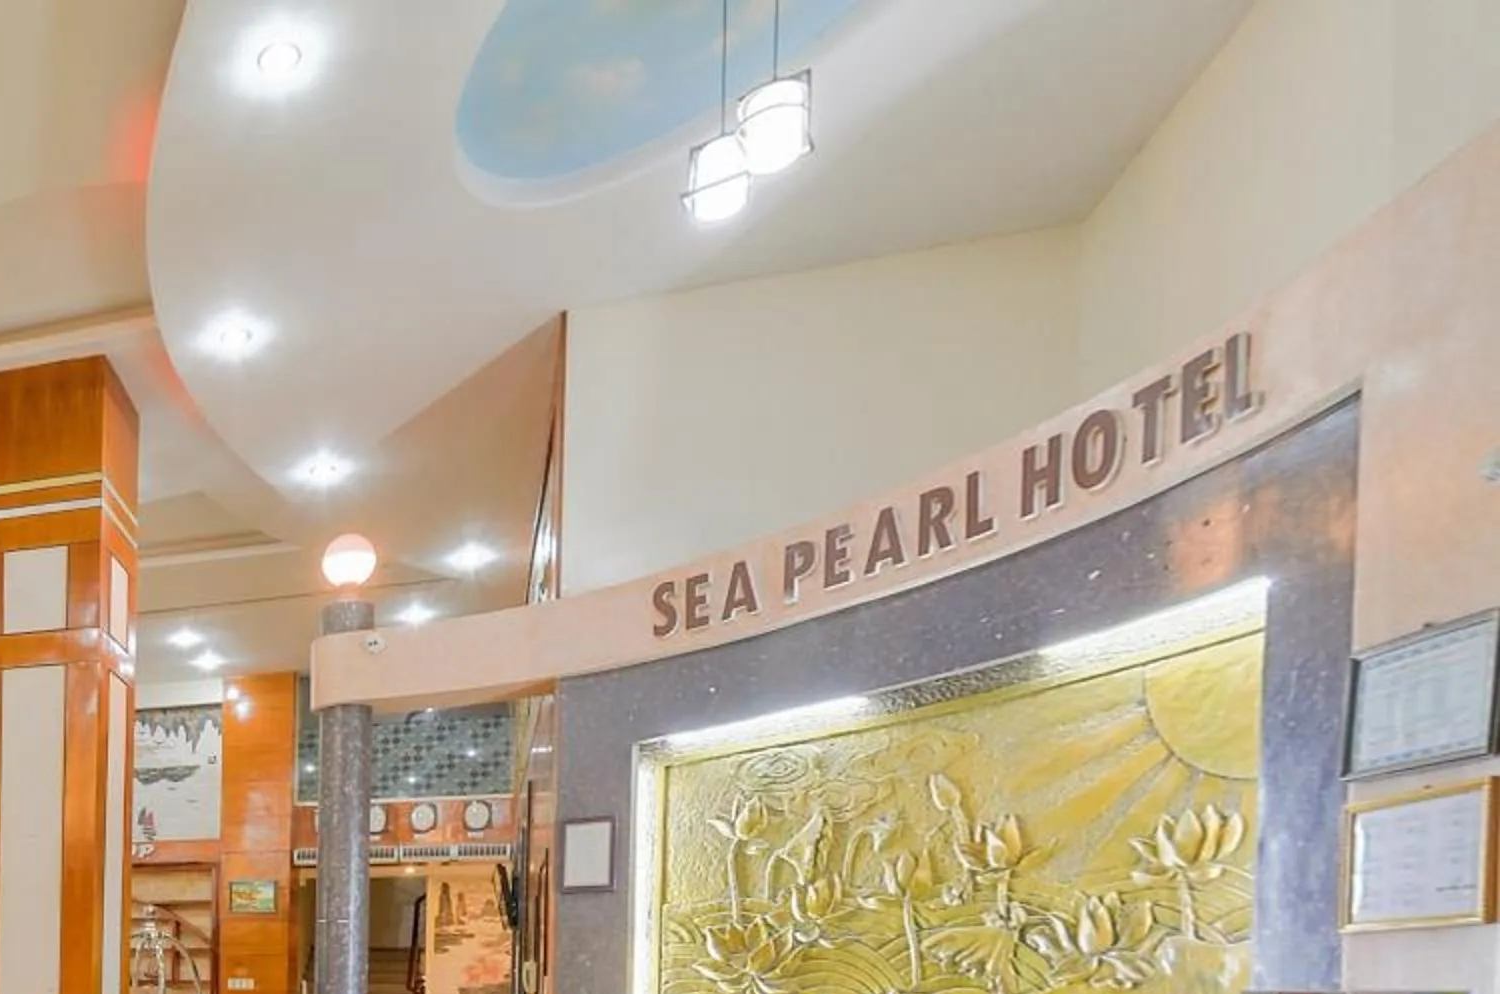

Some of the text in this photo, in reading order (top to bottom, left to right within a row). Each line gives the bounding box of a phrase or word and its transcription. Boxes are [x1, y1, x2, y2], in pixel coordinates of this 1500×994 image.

[652, 330, 1264, 638] SEA PEARL HOTEL
